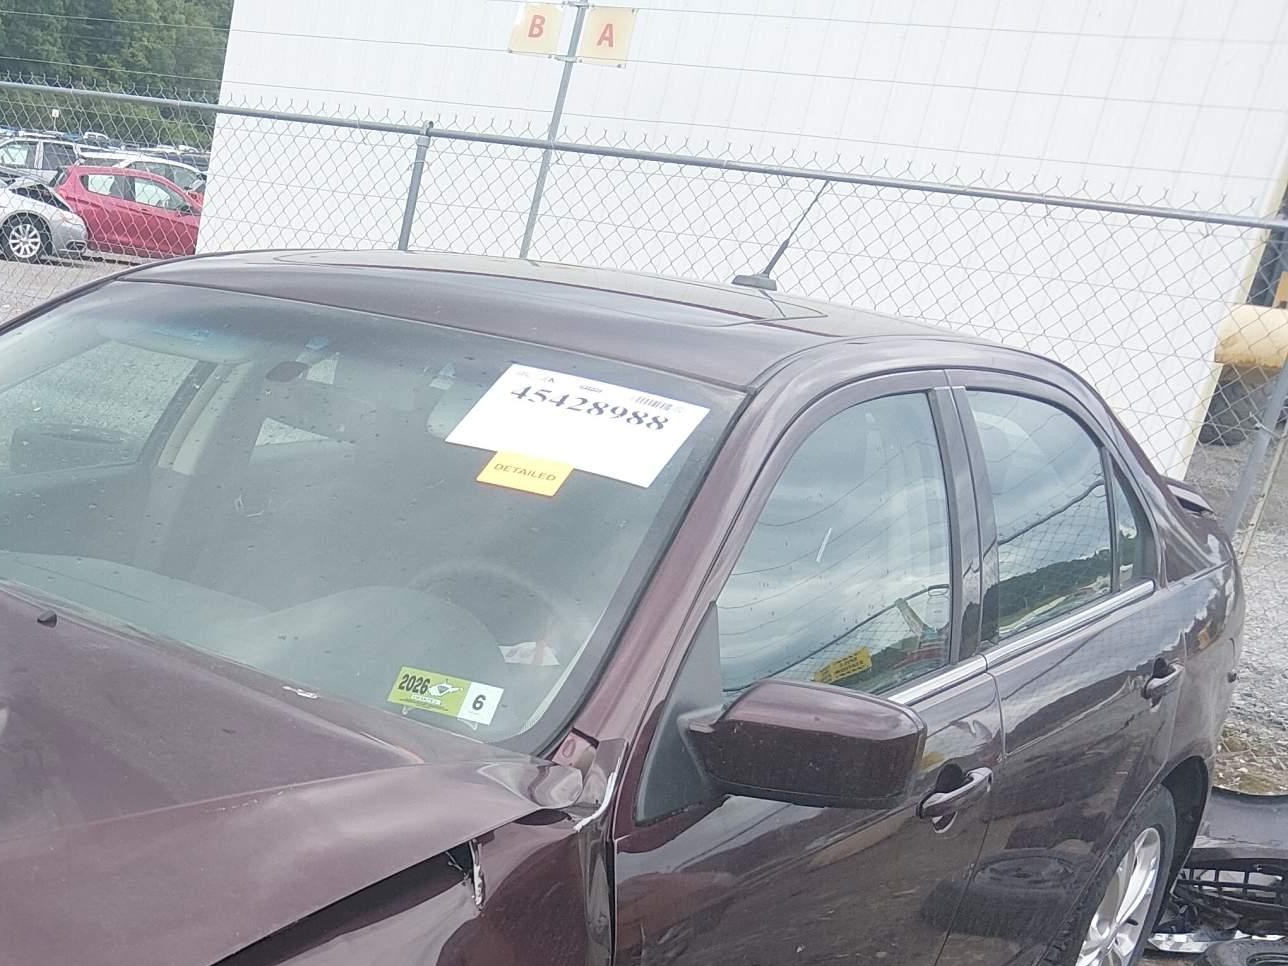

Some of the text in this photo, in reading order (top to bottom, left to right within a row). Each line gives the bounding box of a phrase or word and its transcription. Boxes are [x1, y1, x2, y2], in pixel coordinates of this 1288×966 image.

[527, 14, 546, 38] B
[596, 23, 614, 48] A
[510, 385, 669, 430] 45428988
[493, 463, 557, 481] DETAILED
[398, 673, 431, 695] 2026
[472, 694, 487, 711] 6
